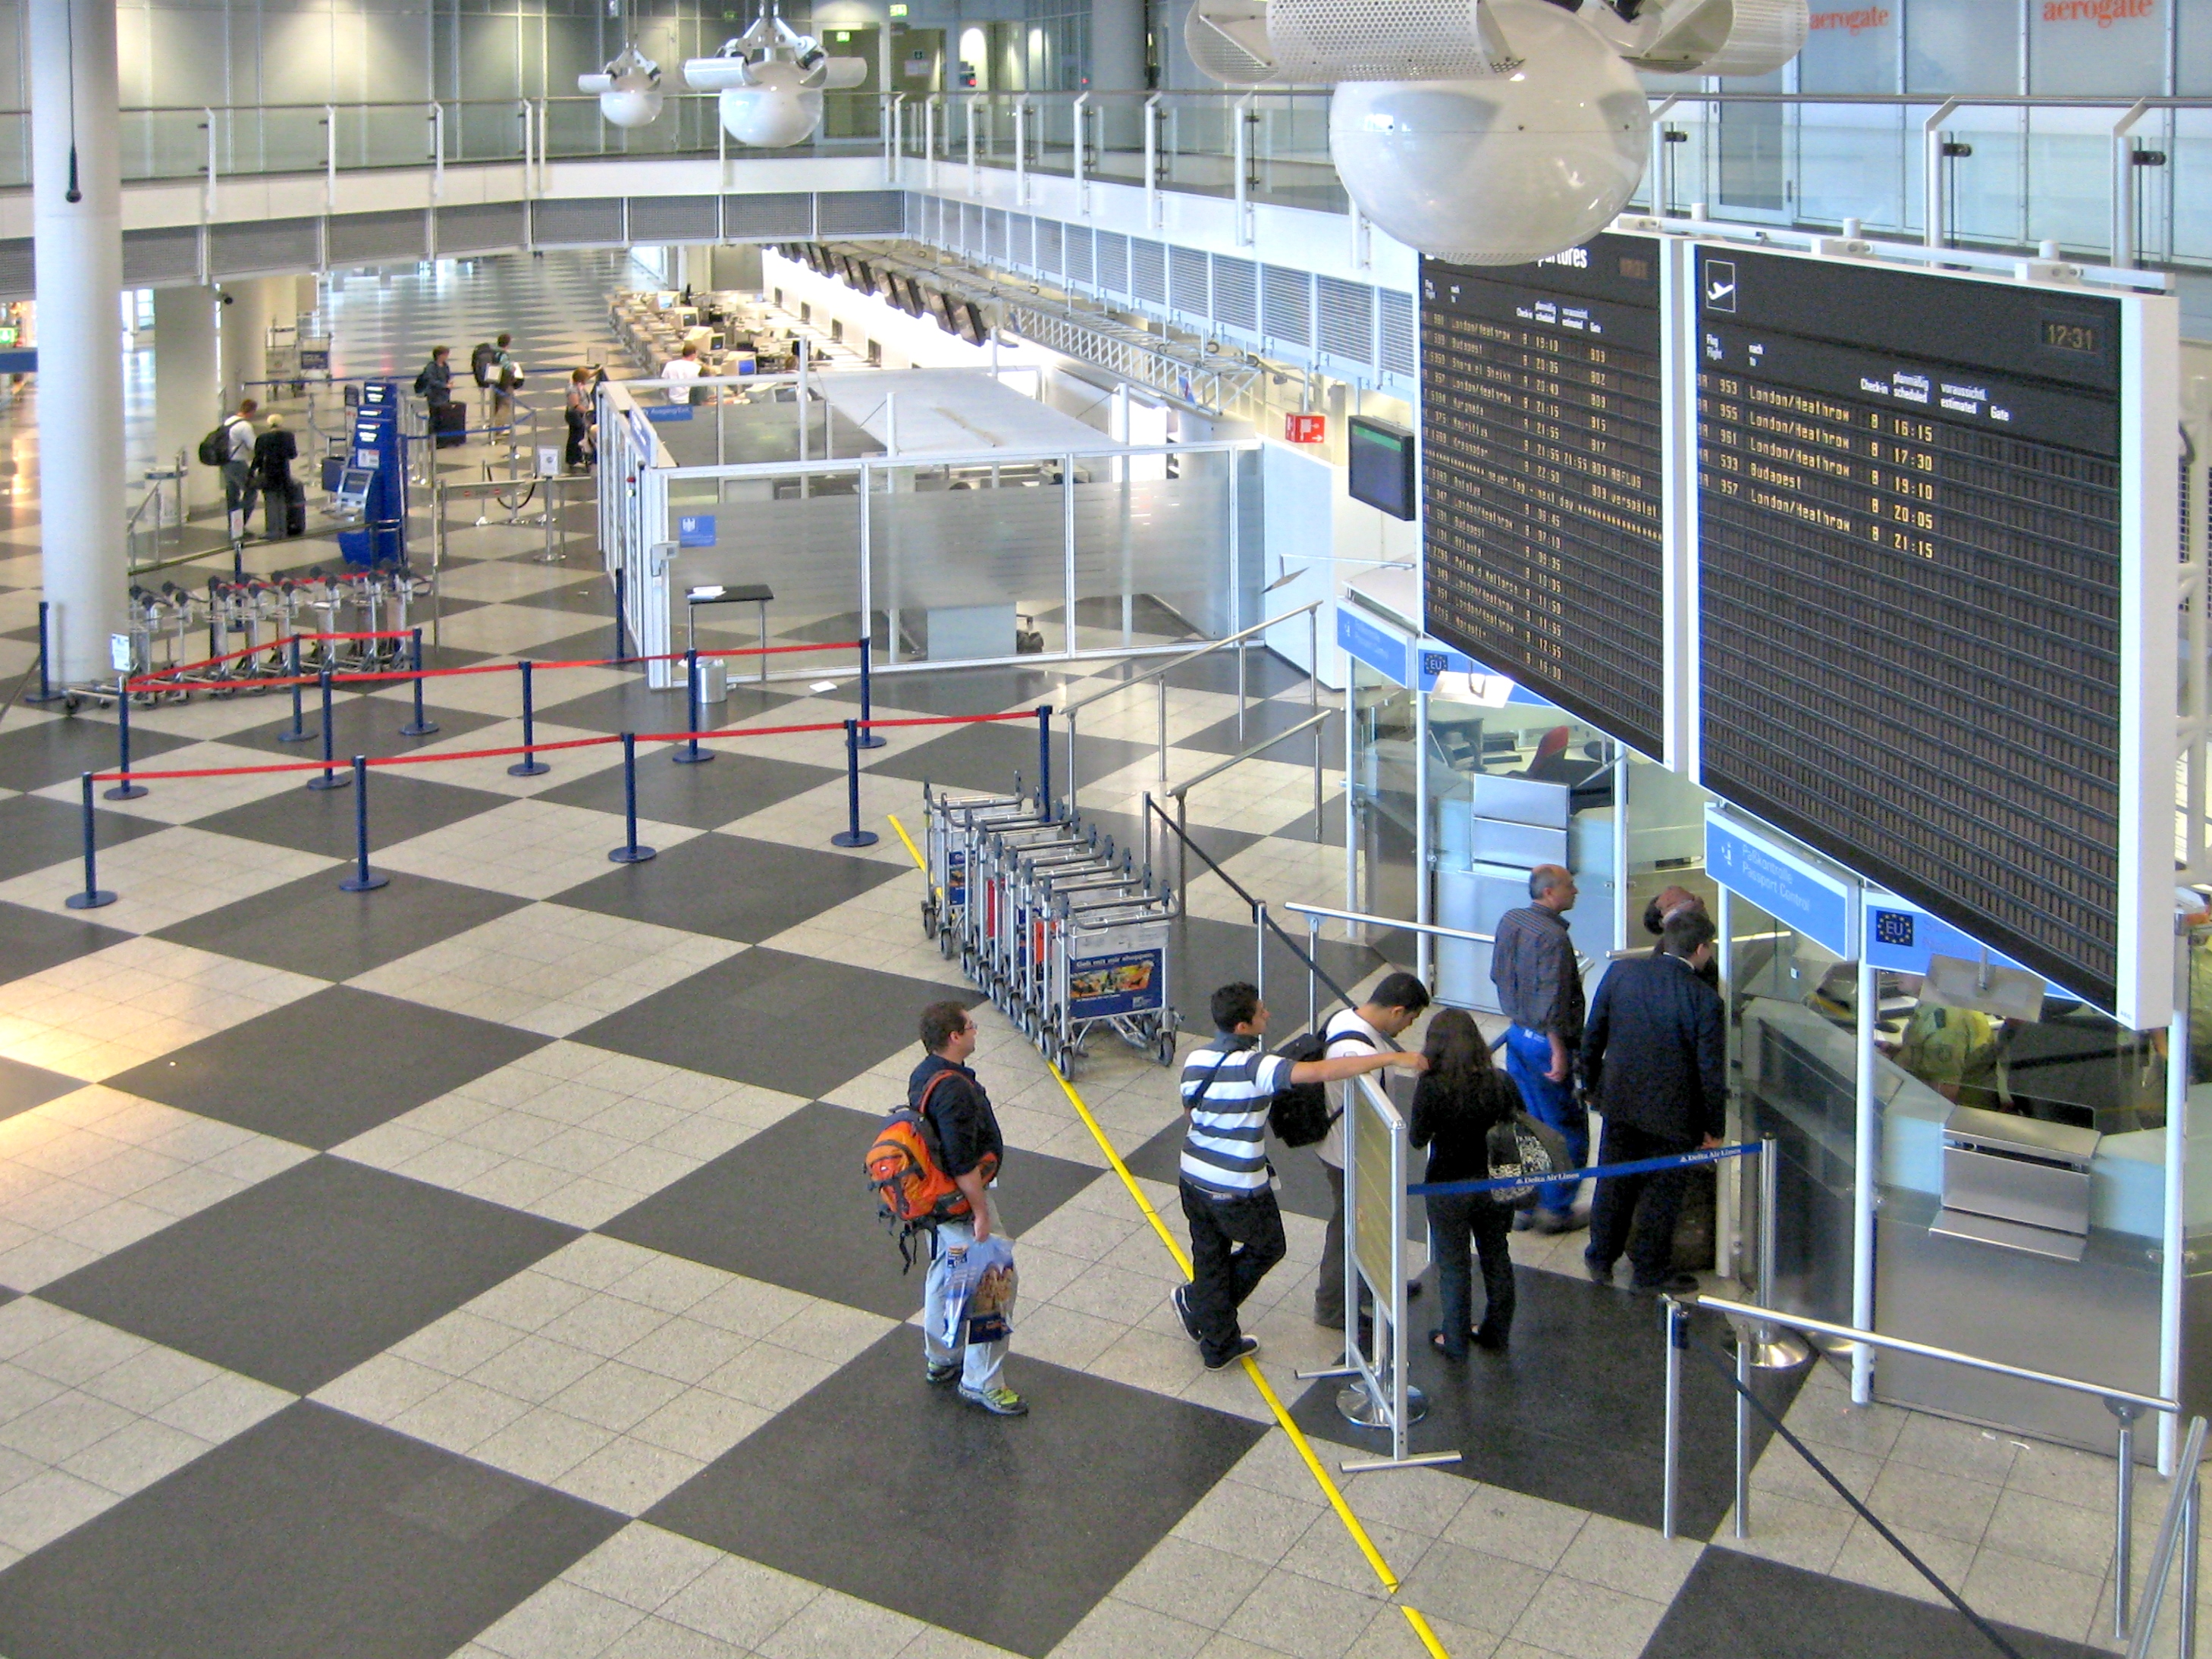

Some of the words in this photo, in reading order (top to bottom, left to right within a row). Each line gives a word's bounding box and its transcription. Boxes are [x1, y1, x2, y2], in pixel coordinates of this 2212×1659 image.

[1809, 6, 1889, 36] aerogate
[2043, 0, 2155, 28] aerogate
[1749, 385, 1850, 423] London/Heathrow
[1894, 419, 1933, 442] 16:15
[1940, 397, 1977, 415] estimated
[1991, 404, 2010, 422] Gate
[1749, 411, 1850, 450] London/Heathrow
[1894, 447, 1933, 472] 17:30
[1749, 437, 1850, 477] London/Heathrow
[1894, 476, 1933, 500] 19:10
[1749, 462, 1801, 490] Budapest
[1894, 504, 1933, 530] 20:05
[1750, 488, 1851, 532] London/Heathrow
[1894, 532, 1933, 559] 21:15
[1430, 659, 1442, 670] EU
[1742, 861, 1778, 894] Passport
[1779, 883, 1811, 912] Control
[1885, 920, 1904, 936] EU
[1687, 1153, 1708, 1161] Delta
